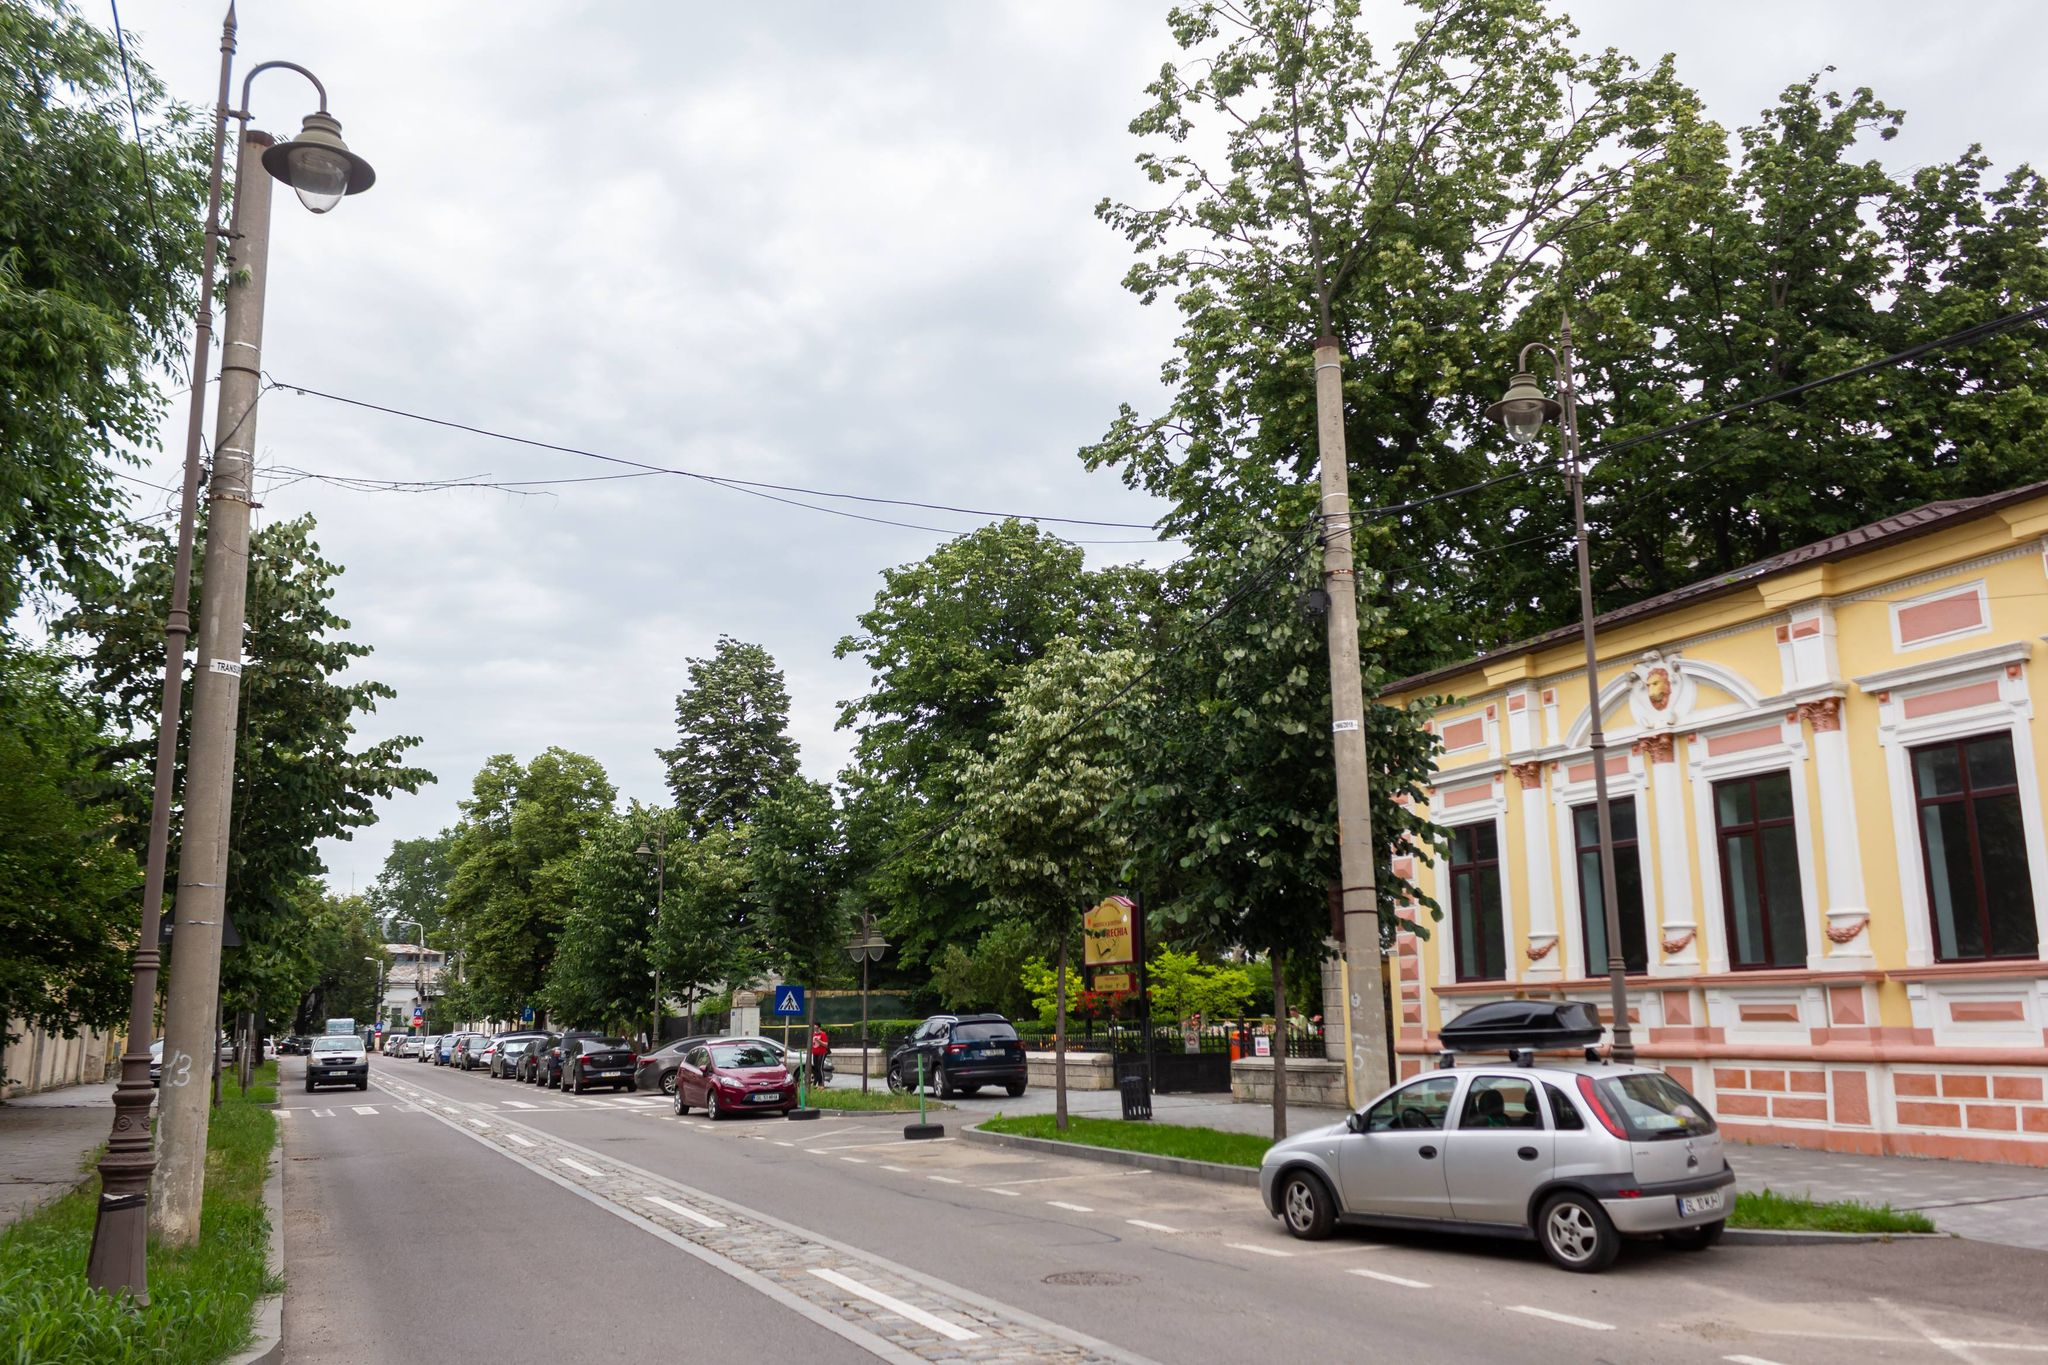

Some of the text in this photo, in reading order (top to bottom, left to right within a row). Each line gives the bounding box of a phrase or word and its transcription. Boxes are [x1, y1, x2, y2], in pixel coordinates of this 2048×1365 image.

[1104, 927, 1128, 938] RECHIA
[525, 1008, 531, 1018] P
[165, 1049, 192, 1087] 13
